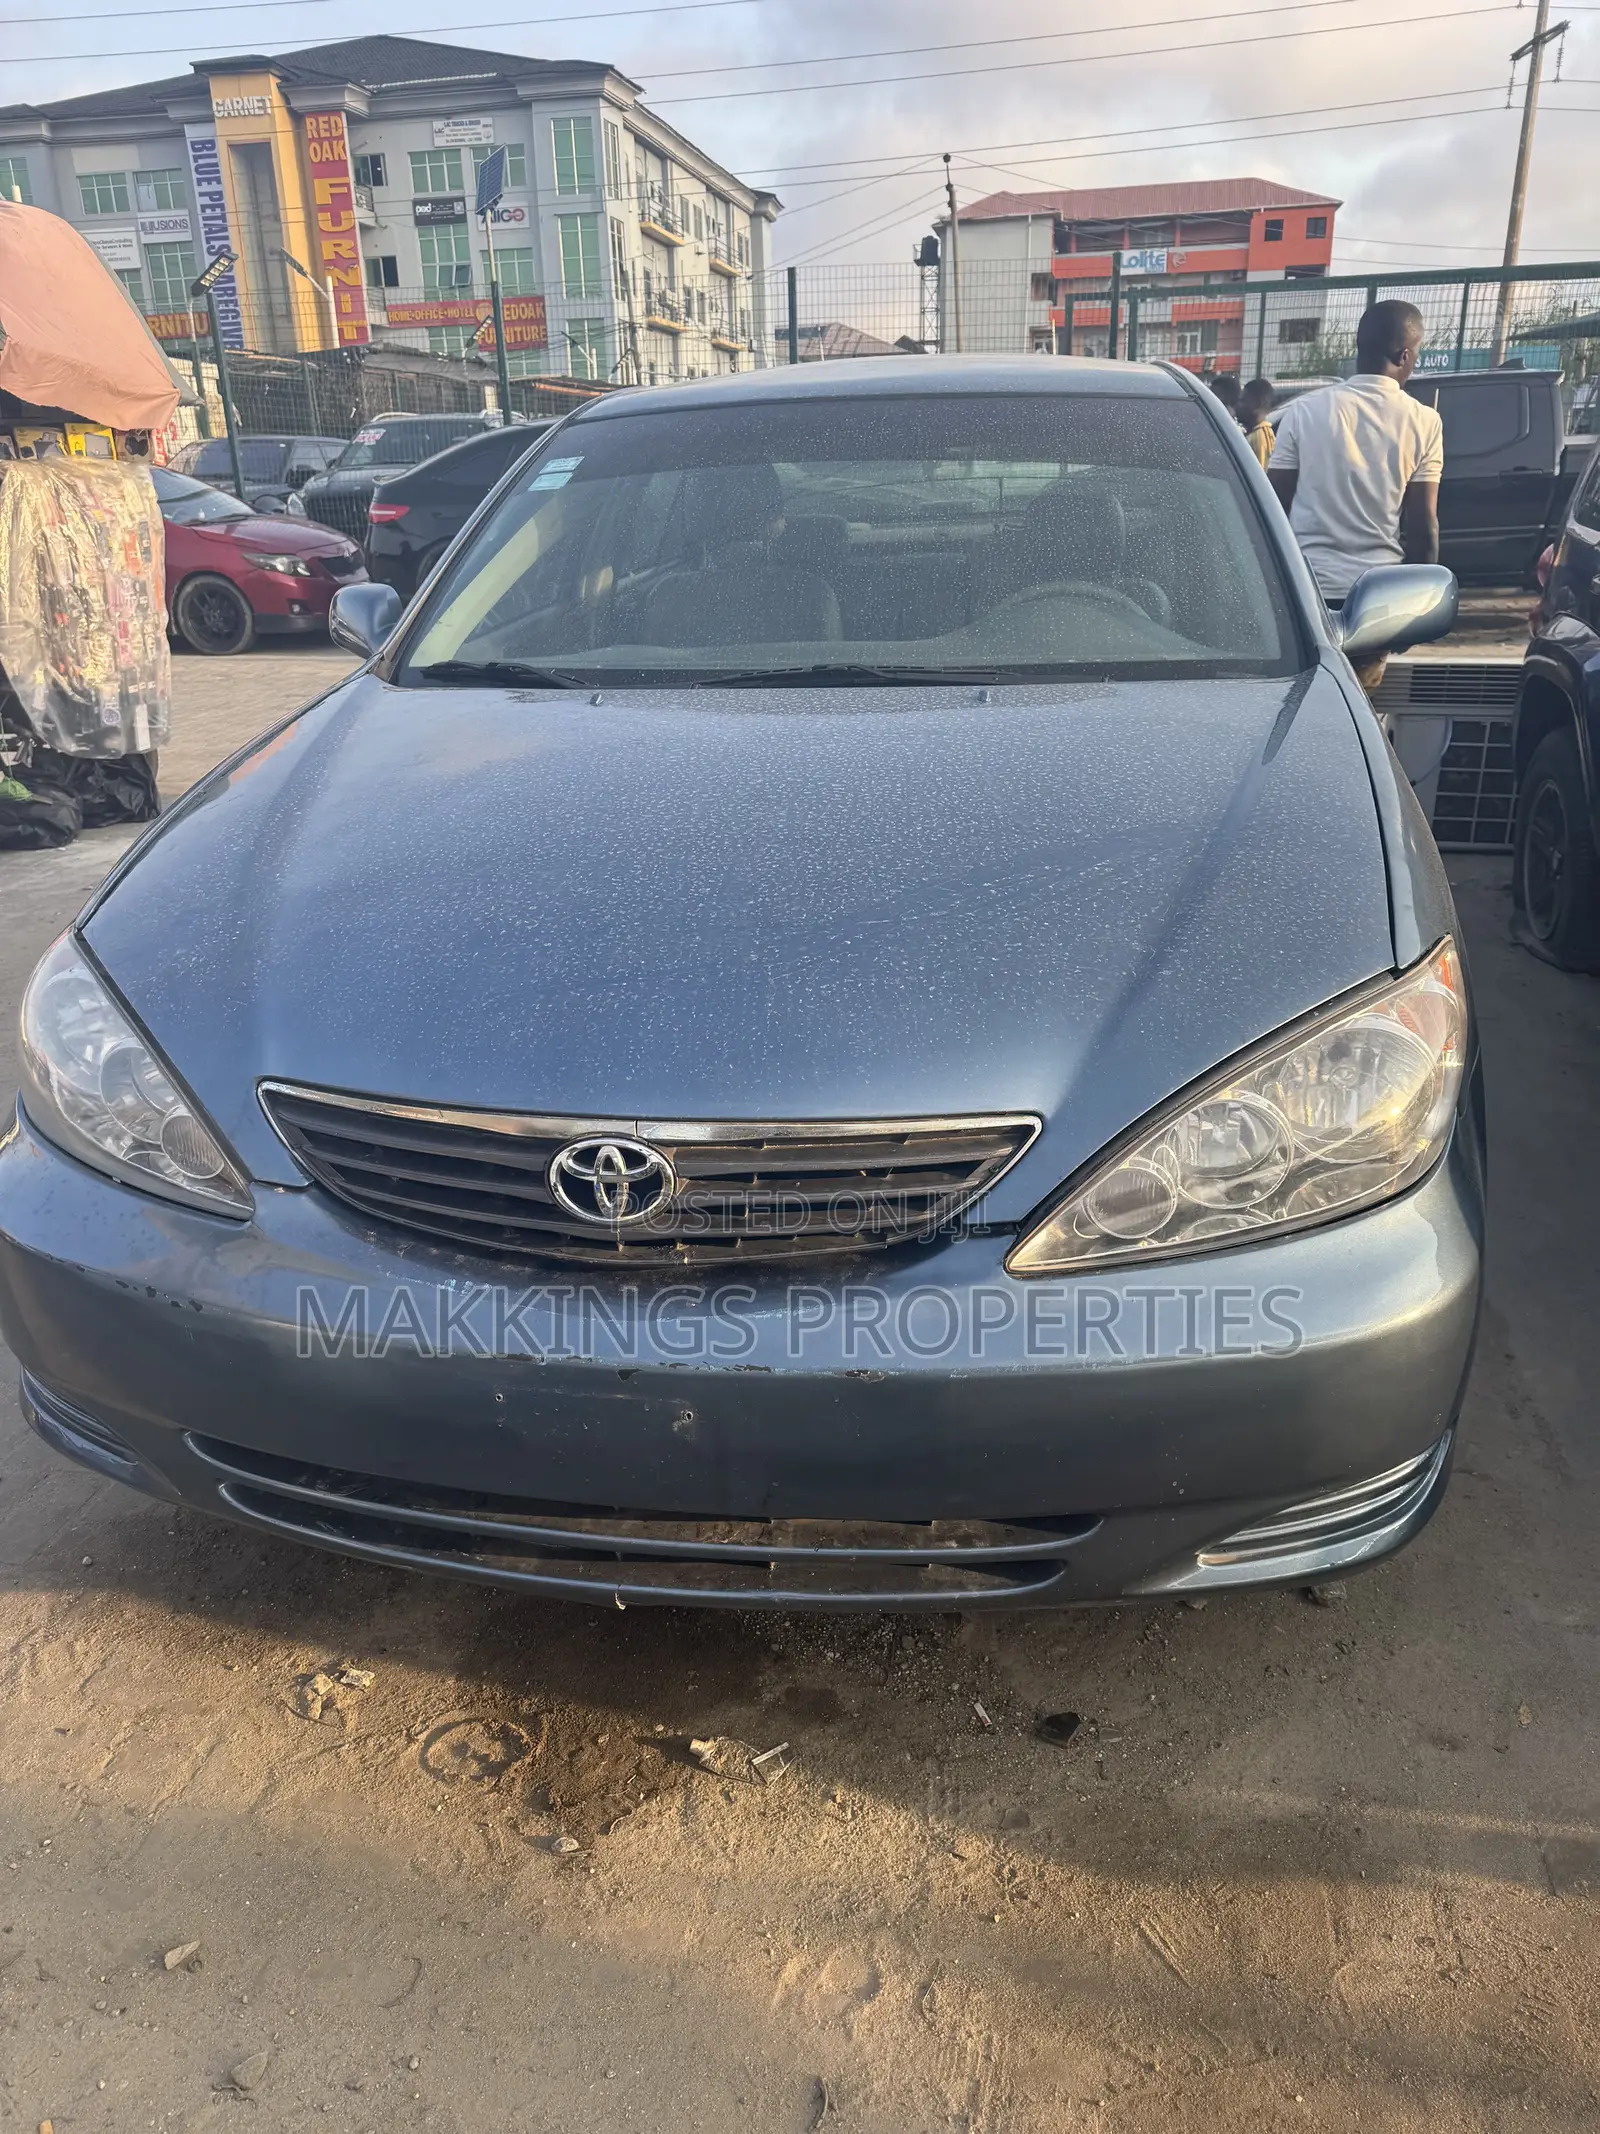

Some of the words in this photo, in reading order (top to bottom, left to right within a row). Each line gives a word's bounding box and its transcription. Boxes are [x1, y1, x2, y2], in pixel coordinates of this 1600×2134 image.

[212, 94, 272, 118] GARNET
[306, 116, 343, 139] RED
[190, 138, 222, 187] BLUE
[309, 140, 347, 163] OAK
[198, 189, 232, 257] PETALS
[503, 303, 545, 321] EDOAK
[1424, 354, 1449, 368] AUTO
